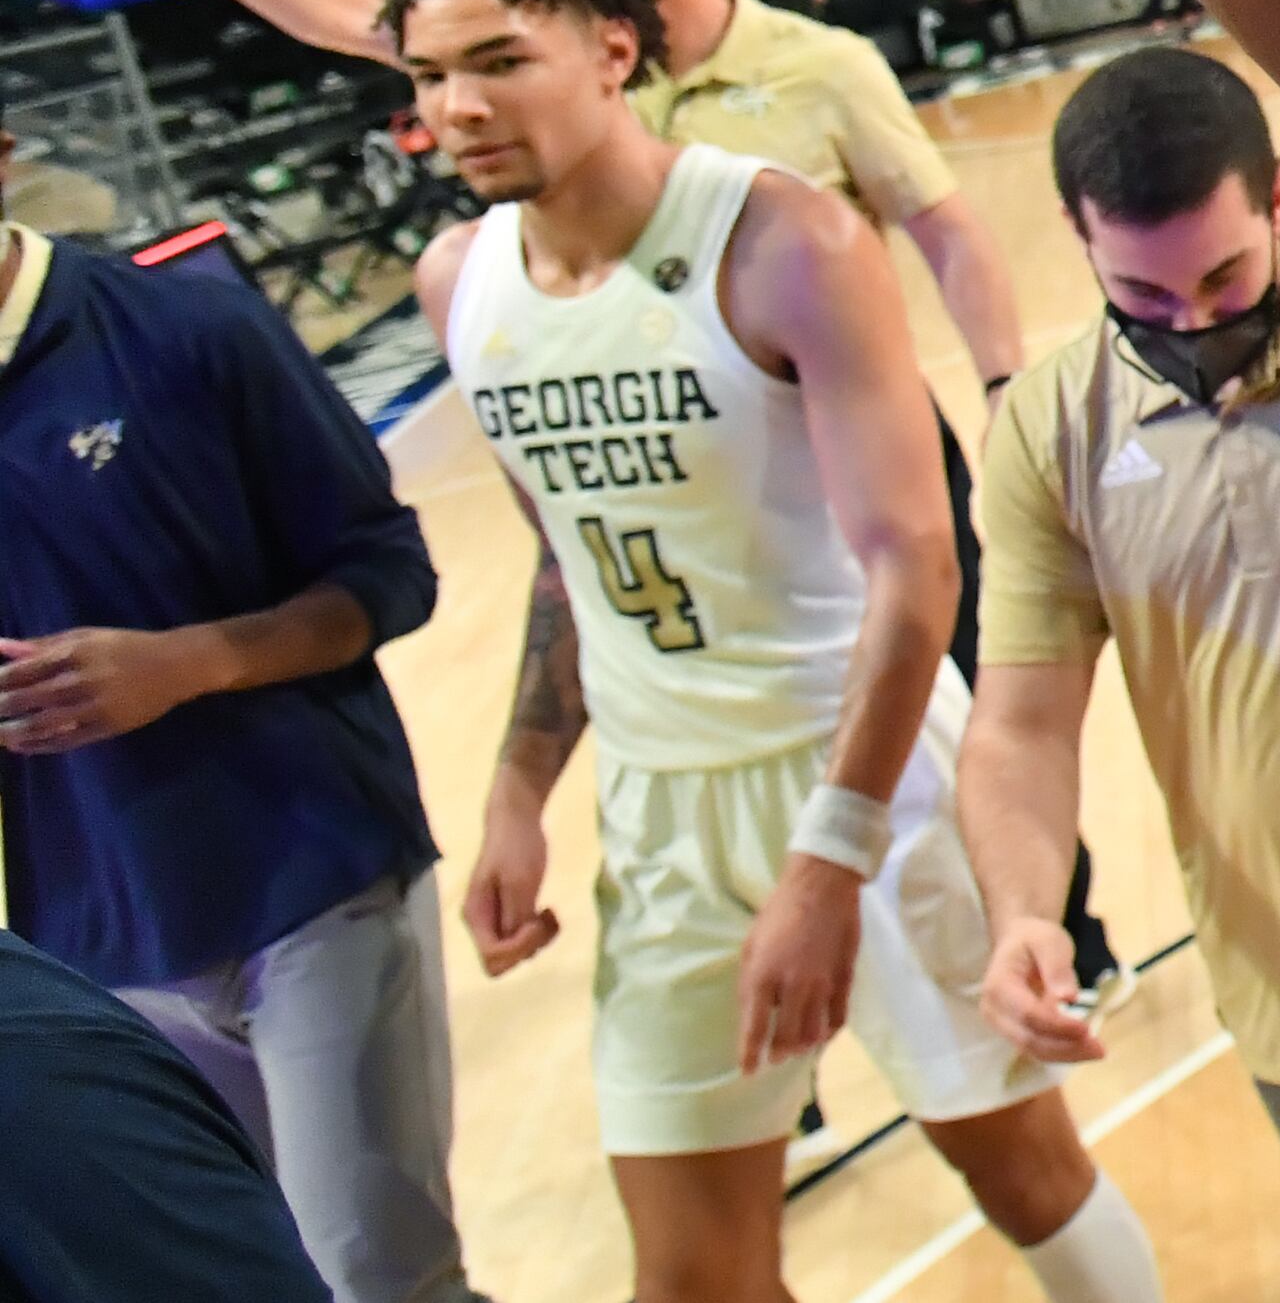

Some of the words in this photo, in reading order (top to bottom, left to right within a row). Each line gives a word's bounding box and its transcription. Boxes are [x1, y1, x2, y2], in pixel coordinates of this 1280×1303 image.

[473, 368, 719, 438] GEORGIA
[523, 433, 688, 494] TECH
[576, 516, 706, 653] 4
